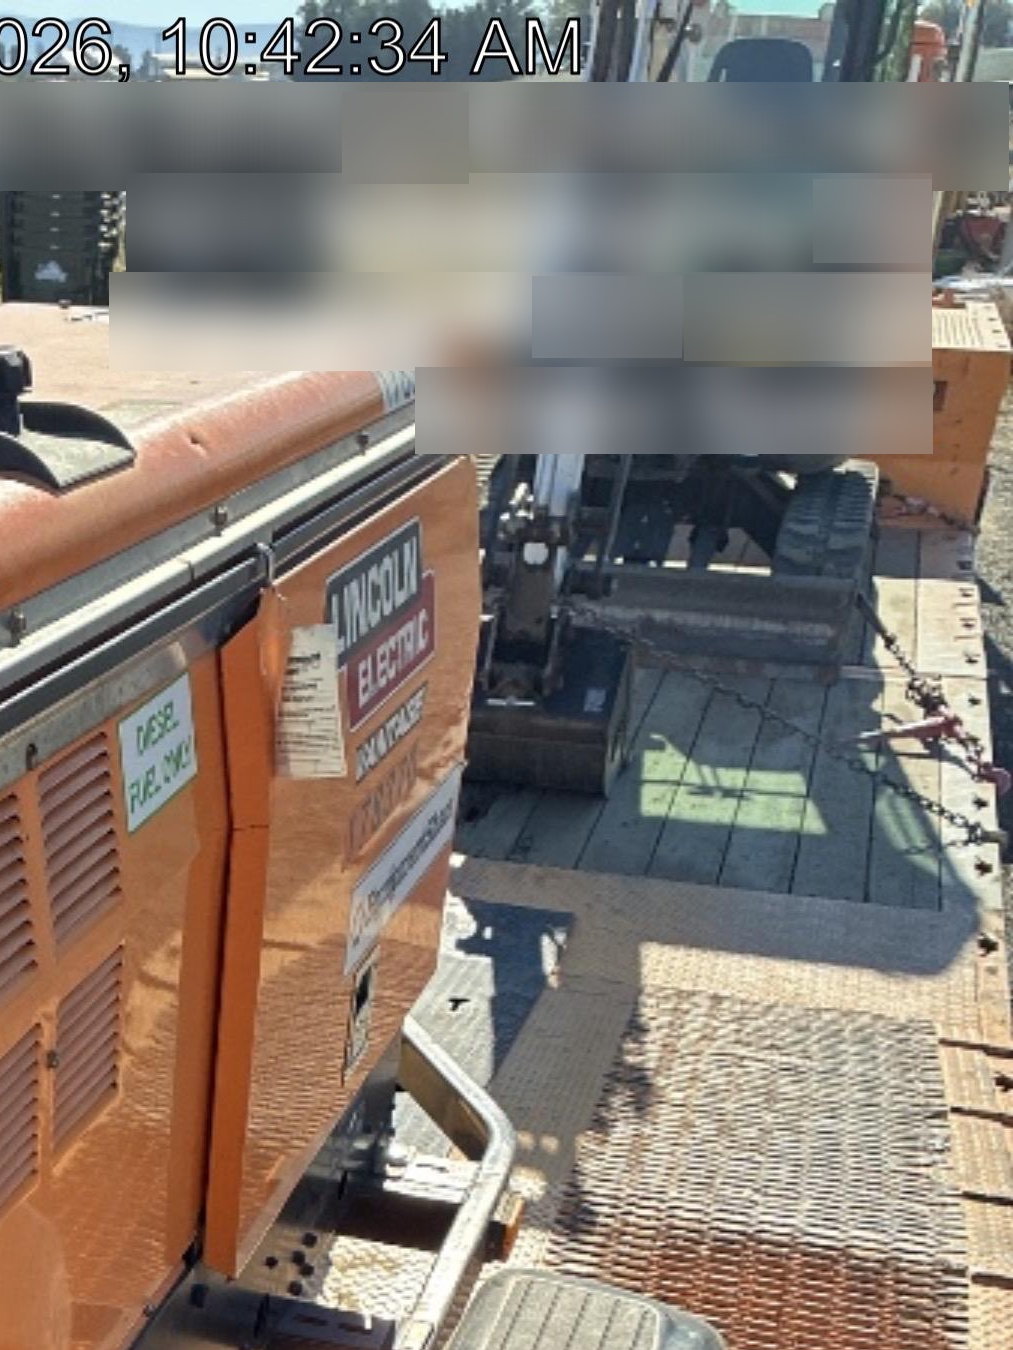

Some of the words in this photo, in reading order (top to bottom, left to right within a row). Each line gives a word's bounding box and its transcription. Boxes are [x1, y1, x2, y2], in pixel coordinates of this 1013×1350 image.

[331, 536, 417, 654] LINCOLN
[358, 608, 429, 709] ELECTRIC
[137, 701, 179, 757] DIESEL
